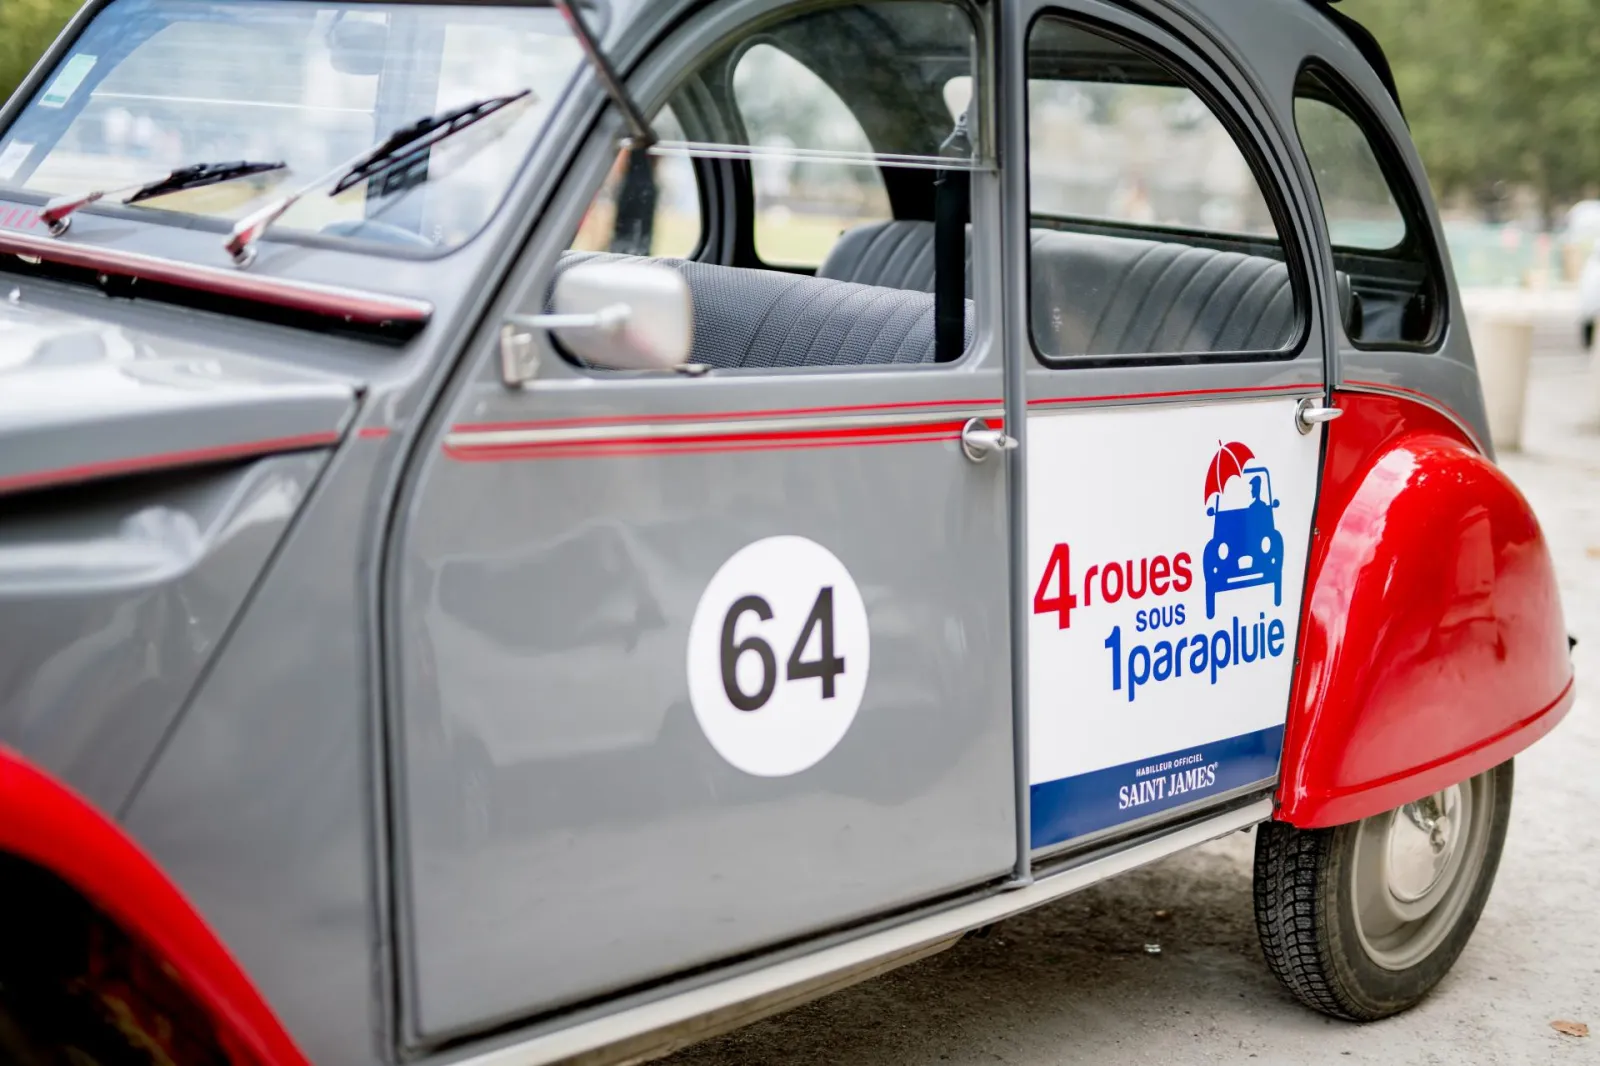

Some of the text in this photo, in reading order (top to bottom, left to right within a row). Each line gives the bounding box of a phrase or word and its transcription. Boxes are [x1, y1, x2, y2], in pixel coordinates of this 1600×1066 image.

[1084, 552, 1193, 607] roues
[1136, 603, 1186, 632] sous
[720, 585, 845, 712] 64
[1136, 753, 1204, 777] HABILLEUR OFFICIEL
[1119, 776, 1167, 810] SAINT
